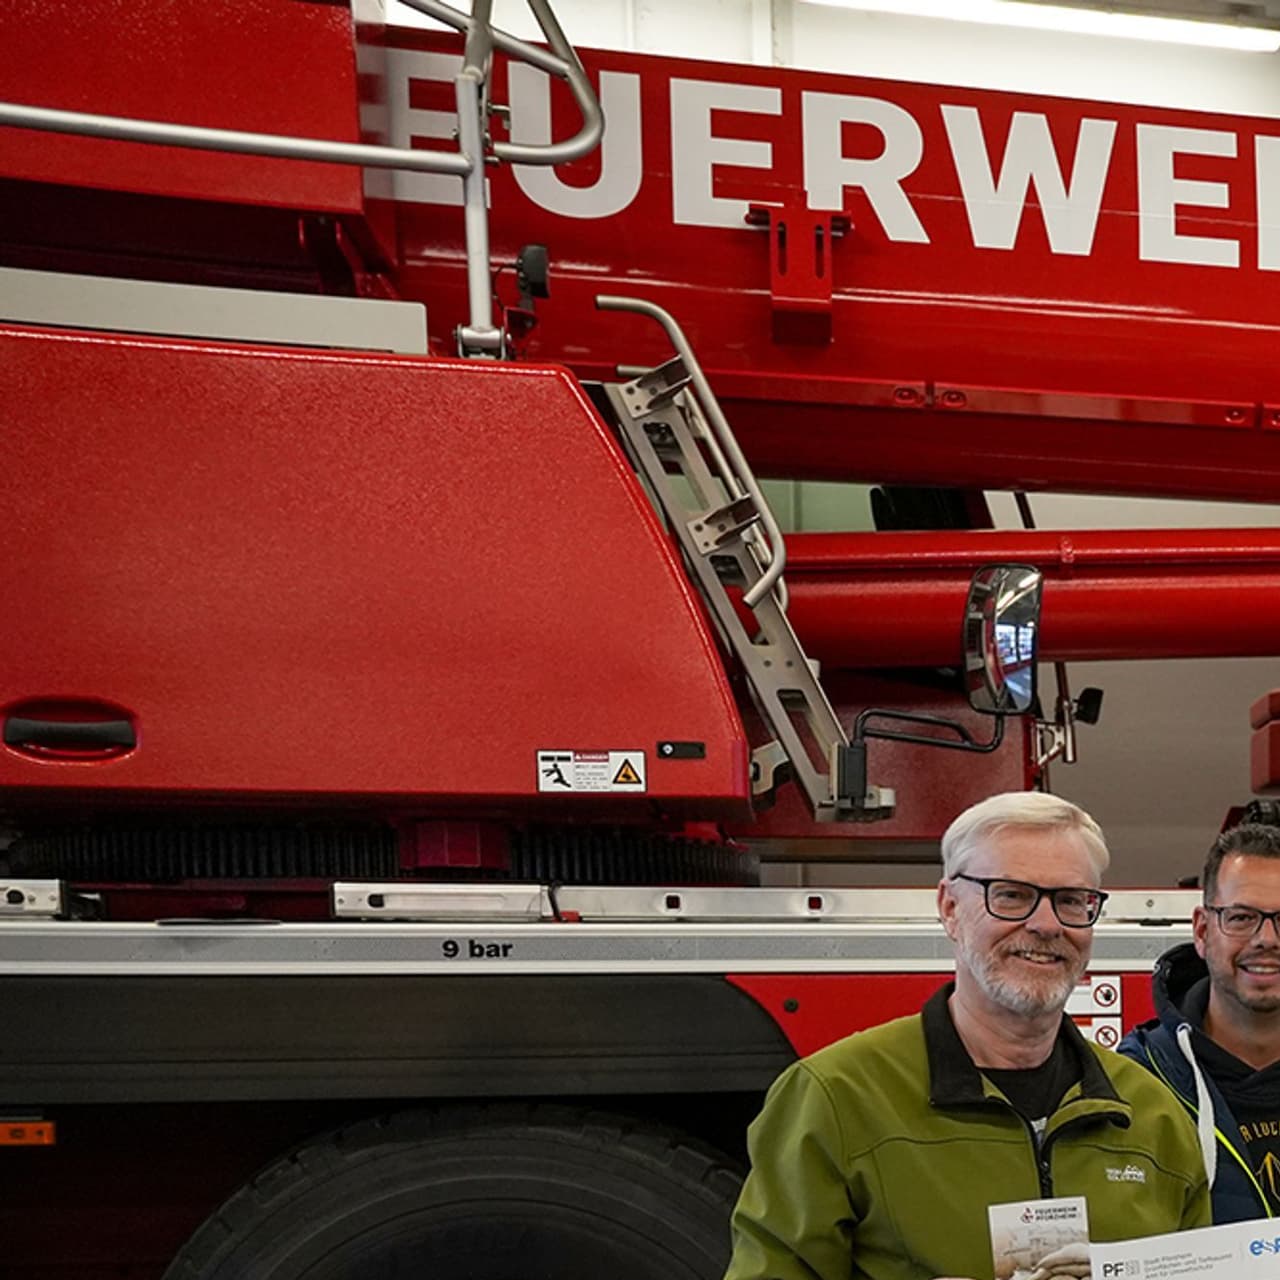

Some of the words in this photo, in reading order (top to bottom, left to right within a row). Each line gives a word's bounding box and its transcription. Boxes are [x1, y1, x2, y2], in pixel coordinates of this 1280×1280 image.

[442, 940, 460, 958] 9
[469, 939, 513, 958] bar
[1103, 1261, 1124, 1278] PF
